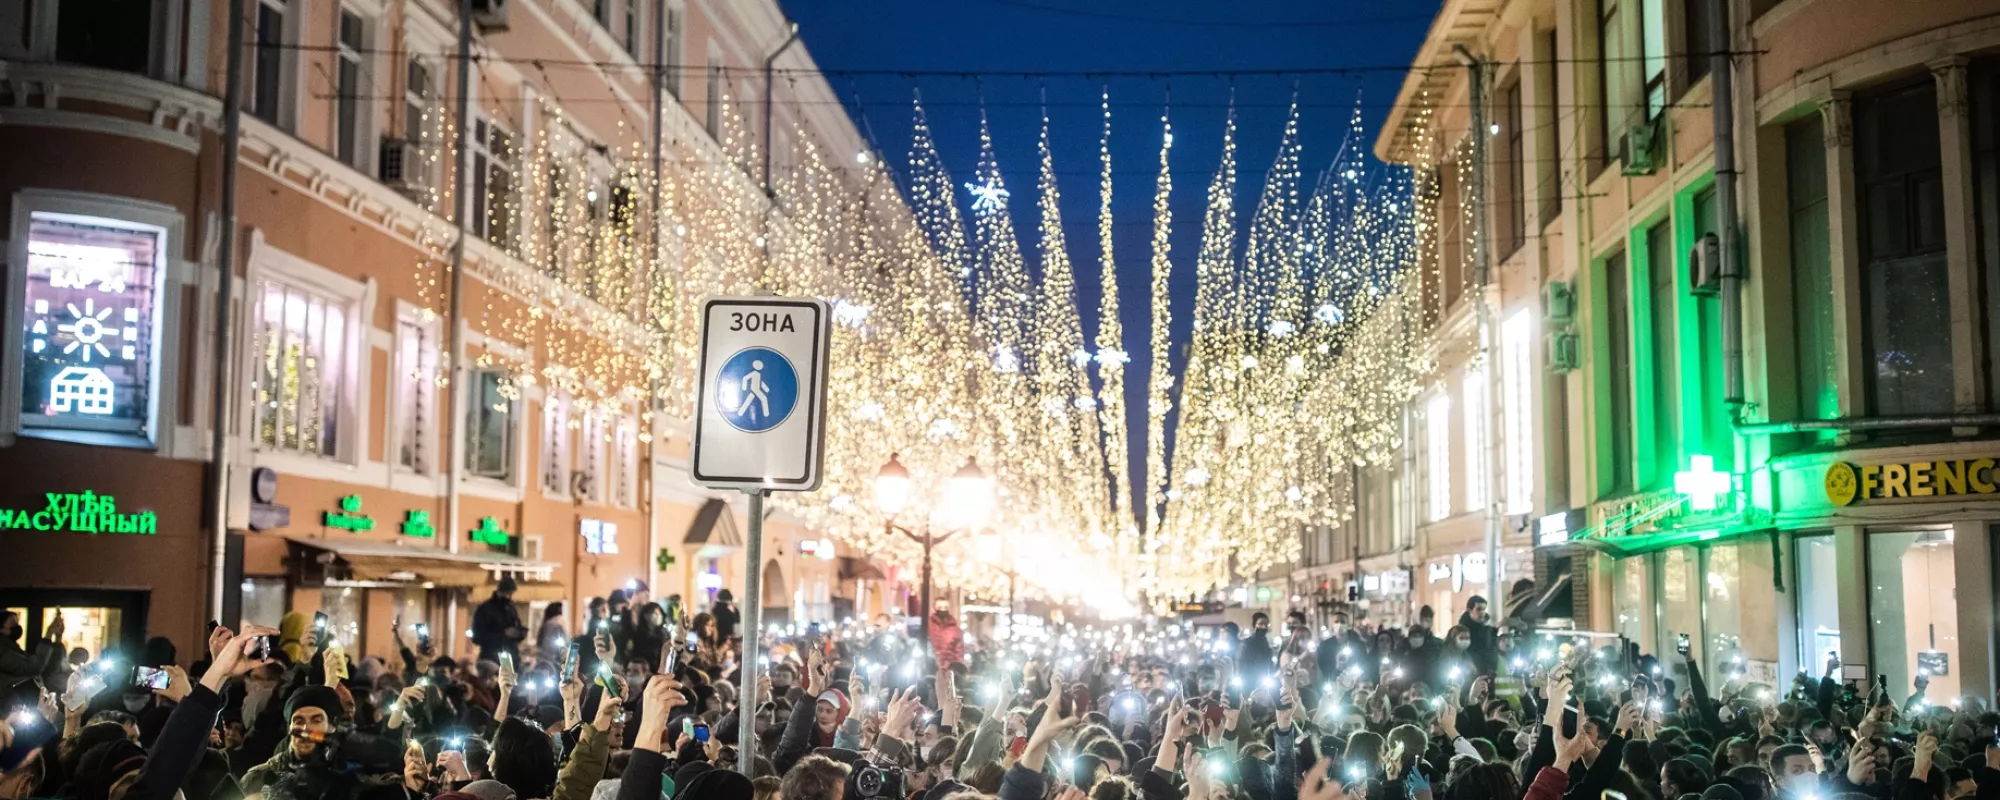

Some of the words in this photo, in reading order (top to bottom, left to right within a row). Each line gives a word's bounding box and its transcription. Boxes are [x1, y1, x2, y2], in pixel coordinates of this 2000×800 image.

[729, 312, 795, 333] ЗОНА
[1861, 457, 1997, 500] FRENC
[0, 509, 157, 535] НАСУЩНЫЙ
